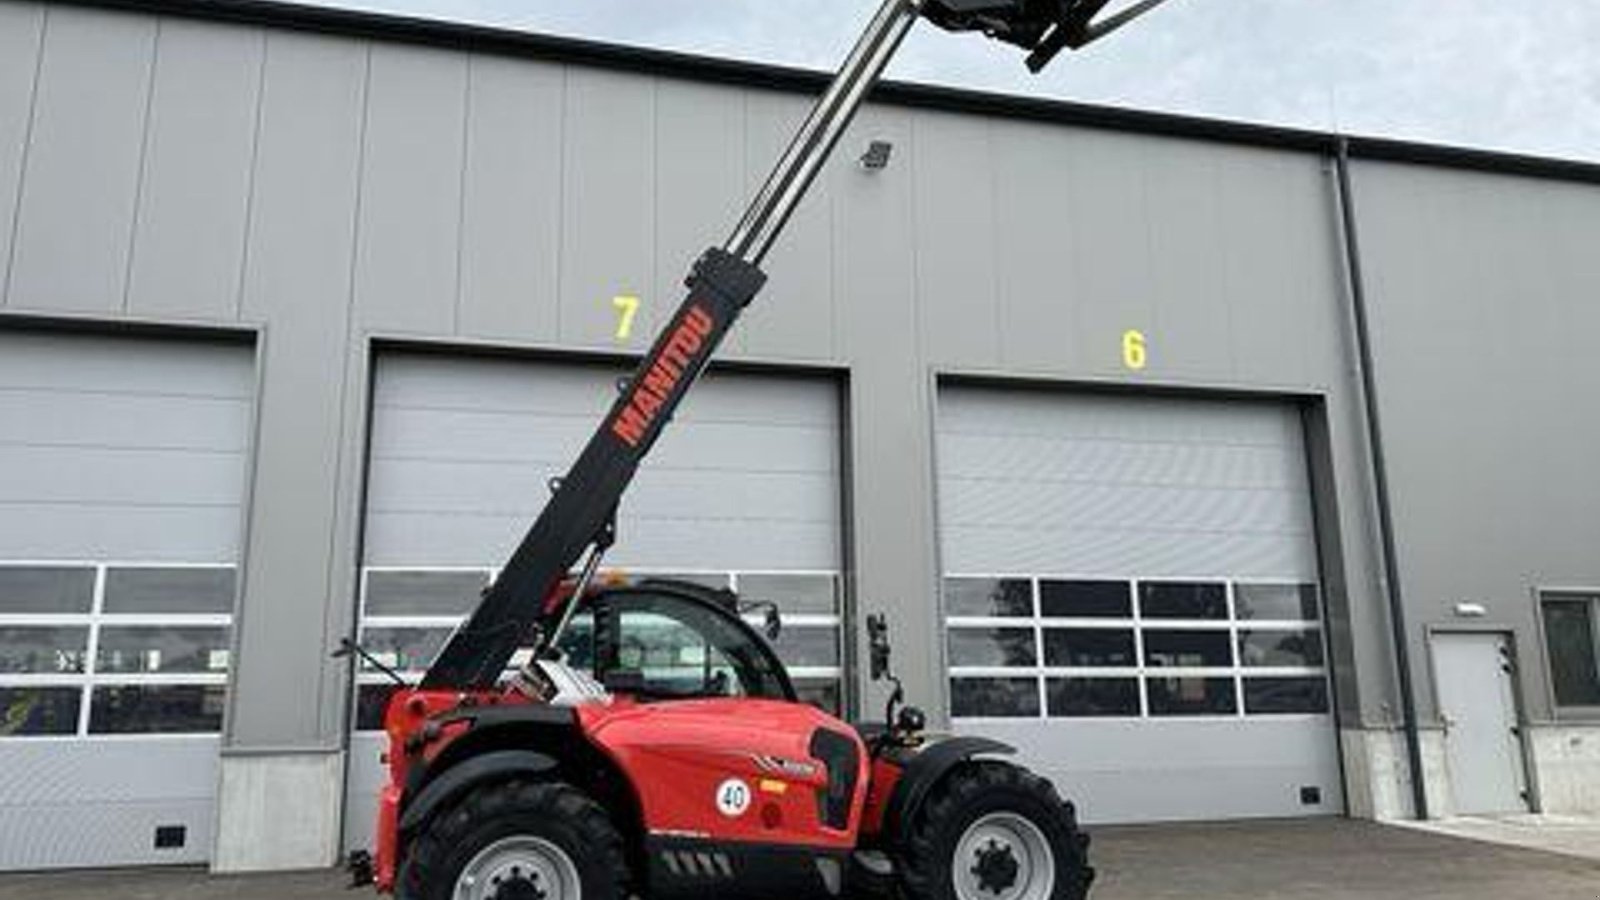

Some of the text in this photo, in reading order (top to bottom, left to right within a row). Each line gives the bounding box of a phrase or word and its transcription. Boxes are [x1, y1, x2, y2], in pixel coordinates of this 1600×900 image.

[612, 296, 639, 339] 7
[1123, 329, 1145, 369] 6
[612, 305, 713, 447] MANITOU
[723, 785, 745, 808] 40
